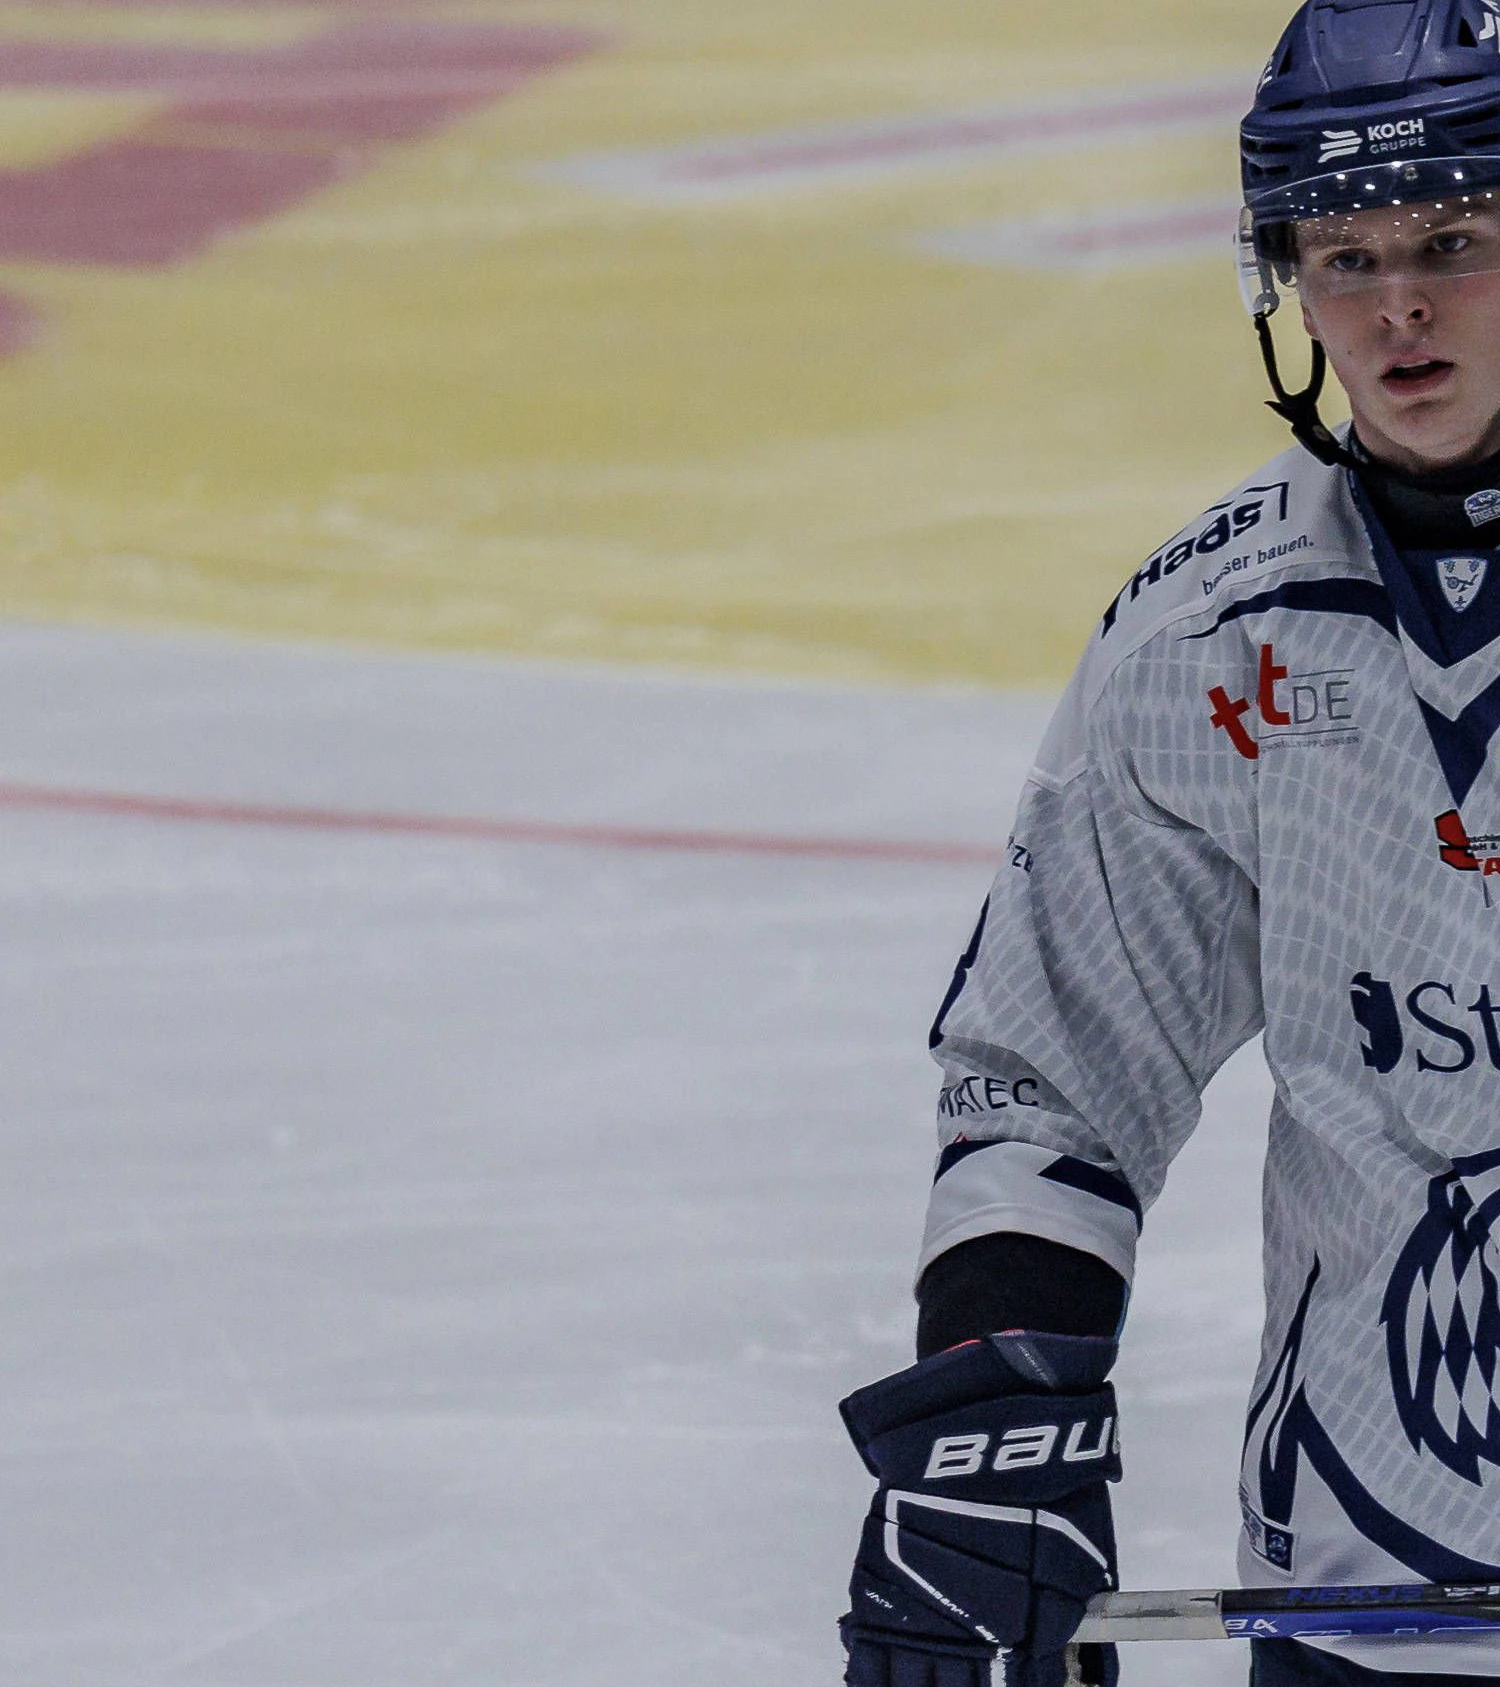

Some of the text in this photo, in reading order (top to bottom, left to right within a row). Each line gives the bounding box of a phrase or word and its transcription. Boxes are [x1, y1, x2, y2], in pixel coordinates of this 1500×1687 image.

[1367, 118, 1425, 142] KOCH
[1369, 136, 1427, 155] GRUPPE
[1257, 534, 1315, 565] bauen.
